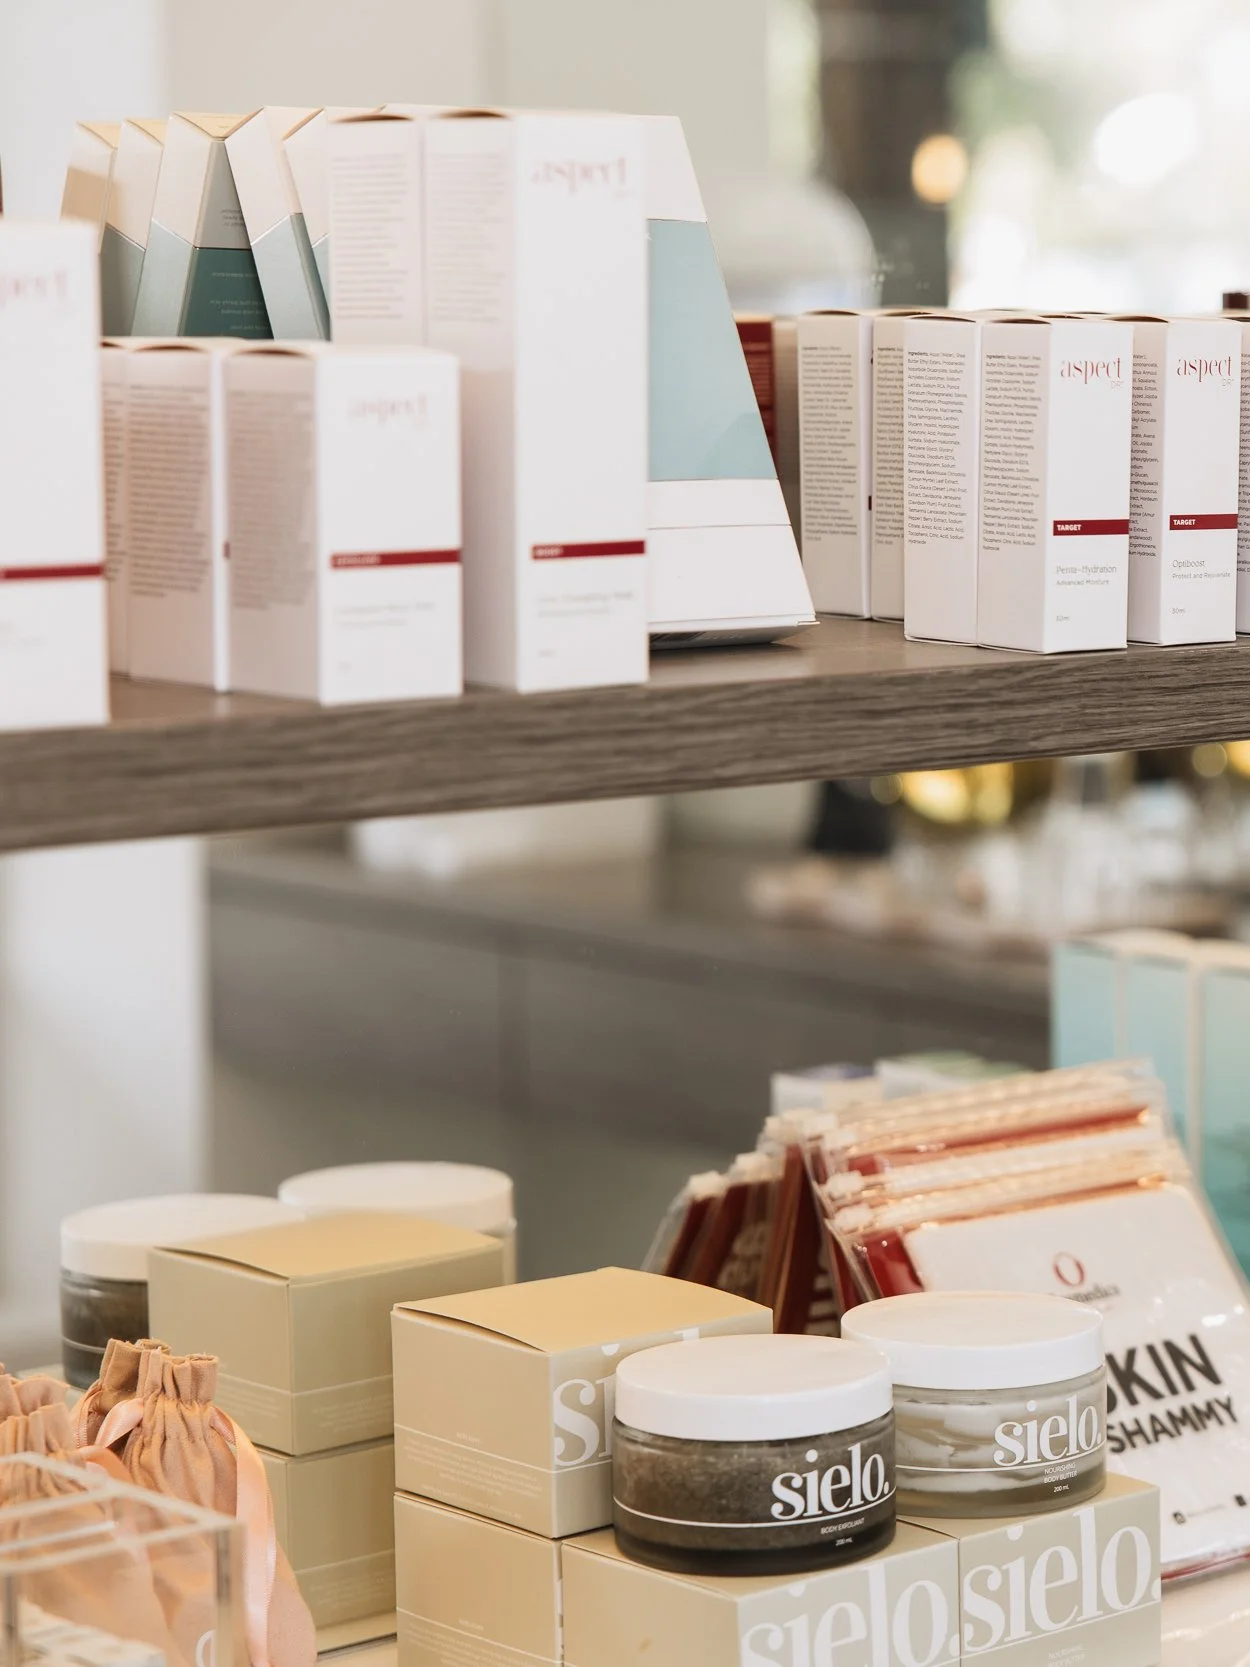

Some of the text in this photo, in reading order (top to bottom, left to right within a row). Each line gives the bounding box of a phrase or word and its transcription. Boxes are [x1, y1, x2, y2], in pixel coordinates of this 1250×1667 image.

[1060, 357, 1120, 385] aspect
[1176, 355, 1232, 383] aspect
[1056, 565, 1117, 575] Penta-Hydration
[1172, 560, 1205, 568] Optiboost
[993, 1394, 1102, 1467] sielo.
[1107, 1395, 1238, 1454] SHAMMY
[771, 1442, 890, 1520] sielo.
[1043, 1470, 1077, 1483] BODY BUTTER
[1044, 1461, 1076, 1474] NOURISHING
[820, 1517, 865, 1534] BODY EXFOLIANT
[963, 1505, 1162, 1652] sielo.
